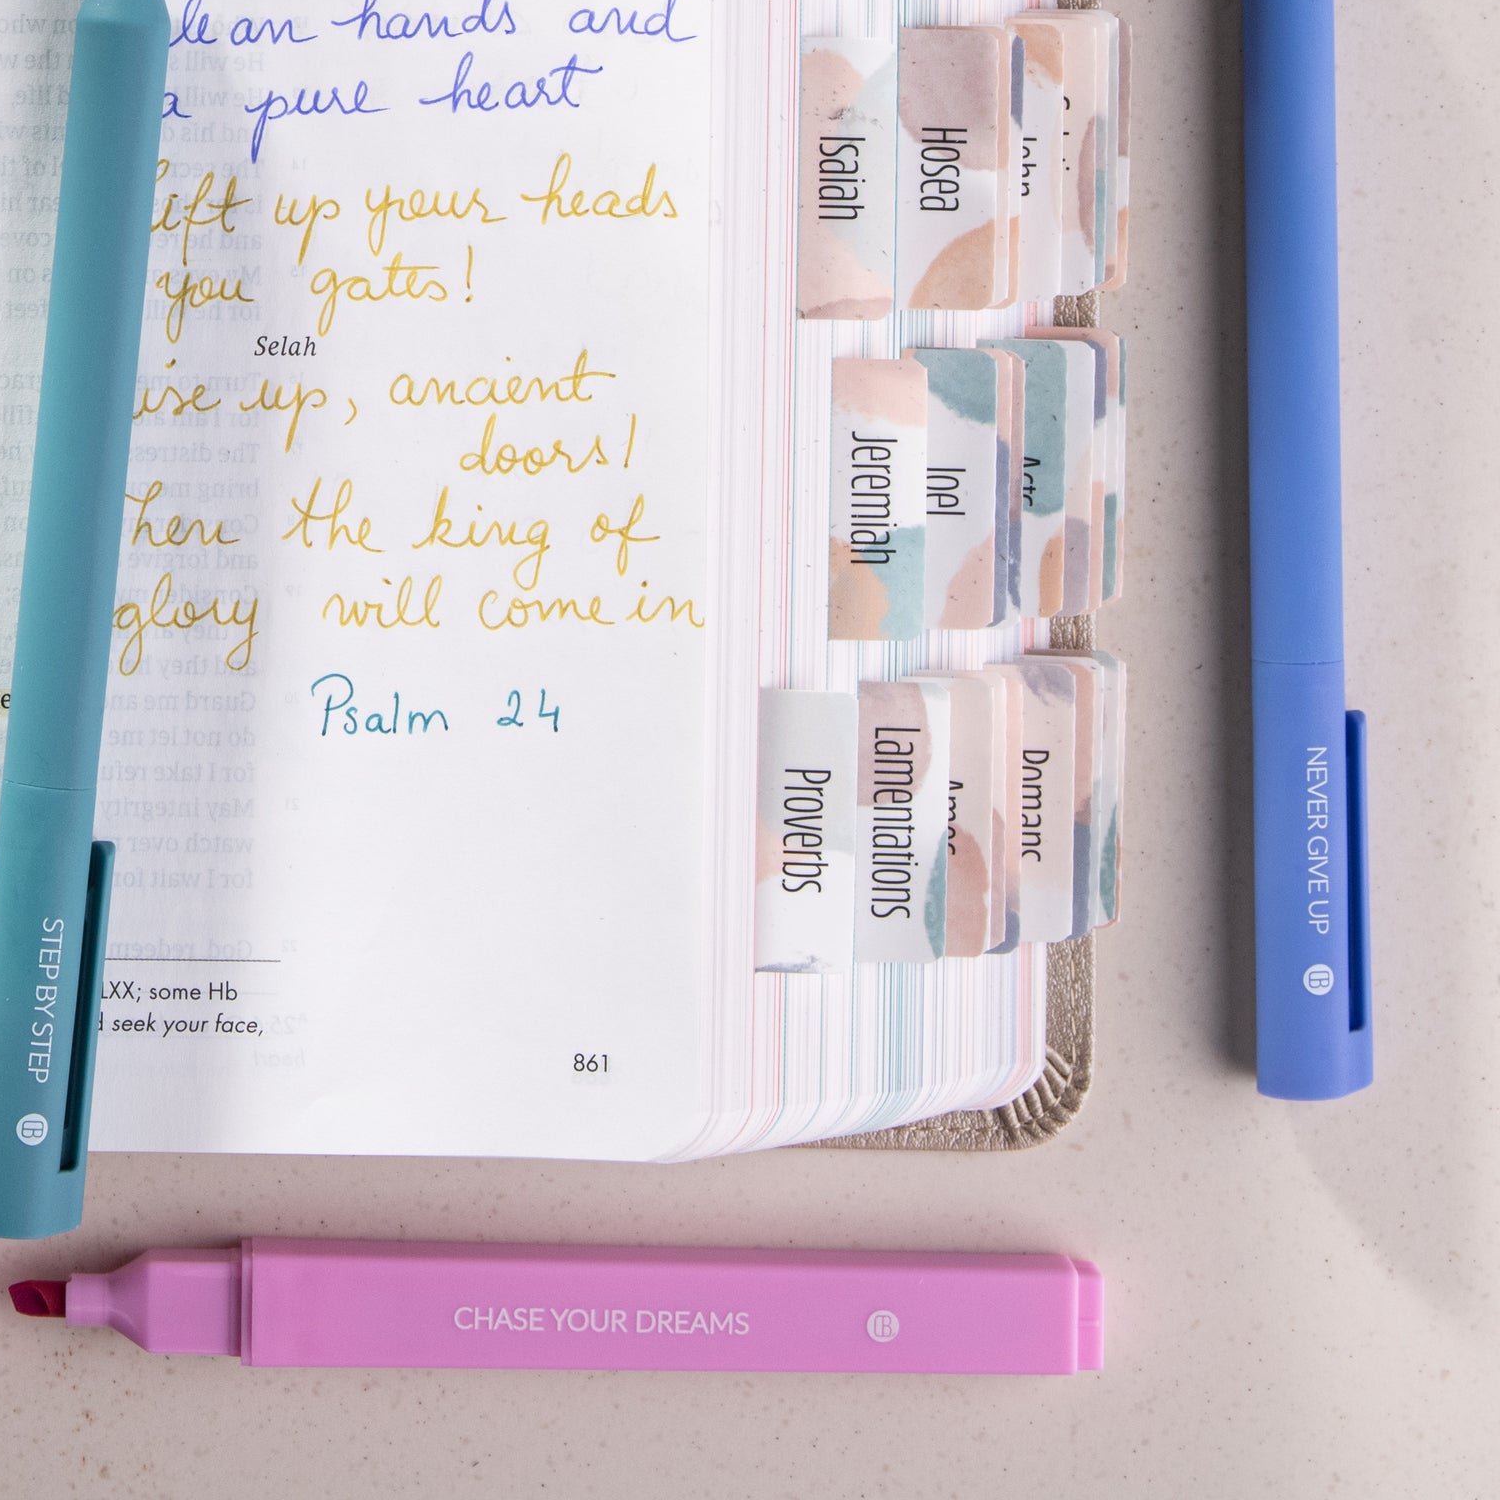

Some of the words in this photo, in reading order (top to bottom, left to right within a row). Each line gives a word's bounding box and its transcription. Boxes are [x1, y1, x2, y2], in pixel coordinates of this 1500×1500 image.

[244, 81, 389, 163] pure
[418, 51, 604, 115] heart
[818, 136, 866, 220] Isaiah
[919, 127, 968, 211] Hosea
[274, 192, 341, 268] up
[365, 185, 507, 255] your
[520, 152, 679, 225] heads
[155, 269, 255, 344] you
[253, 335, 317, 357] Selah
[132, 358, 222, 420] ise
[389, 348, 617, 407] ancient
[124, 479, 241, 548] hen
[280, 476, 387, 553] the
[411, 485, 550, 589] king
[589, 493, 662, 576] of
[850, 430, 898, 564] Jeremiah
[112, 573, 260, 676] glory
[322, 574, 441, 628] will
[478, 589, 615, 630] come
[624, 579, 706, 628] in
[311, 673, 450, 737] Psalm
[496, 688, 561, 734] 24
[870, 726, 921, 919] Lamentations
[1306, 746, 1328, 831] NEVER
[781, 768, 832, 893] Proverbs
[1307, 835, 1329, 894] GIVE
[38, 917, 65, 980] STEP
[1308, 900, 1329, 934] UP
[34, 985, 58, 1018] BY
[28, 1021, 54, 1083] STEP
[573, 1052, 608, 1073] 861
[453, 1306, 544, 1332] CHASE
[549, 1308, 629, 1333] YOUR
[635, 1310, 750, 1336] DREAMS
